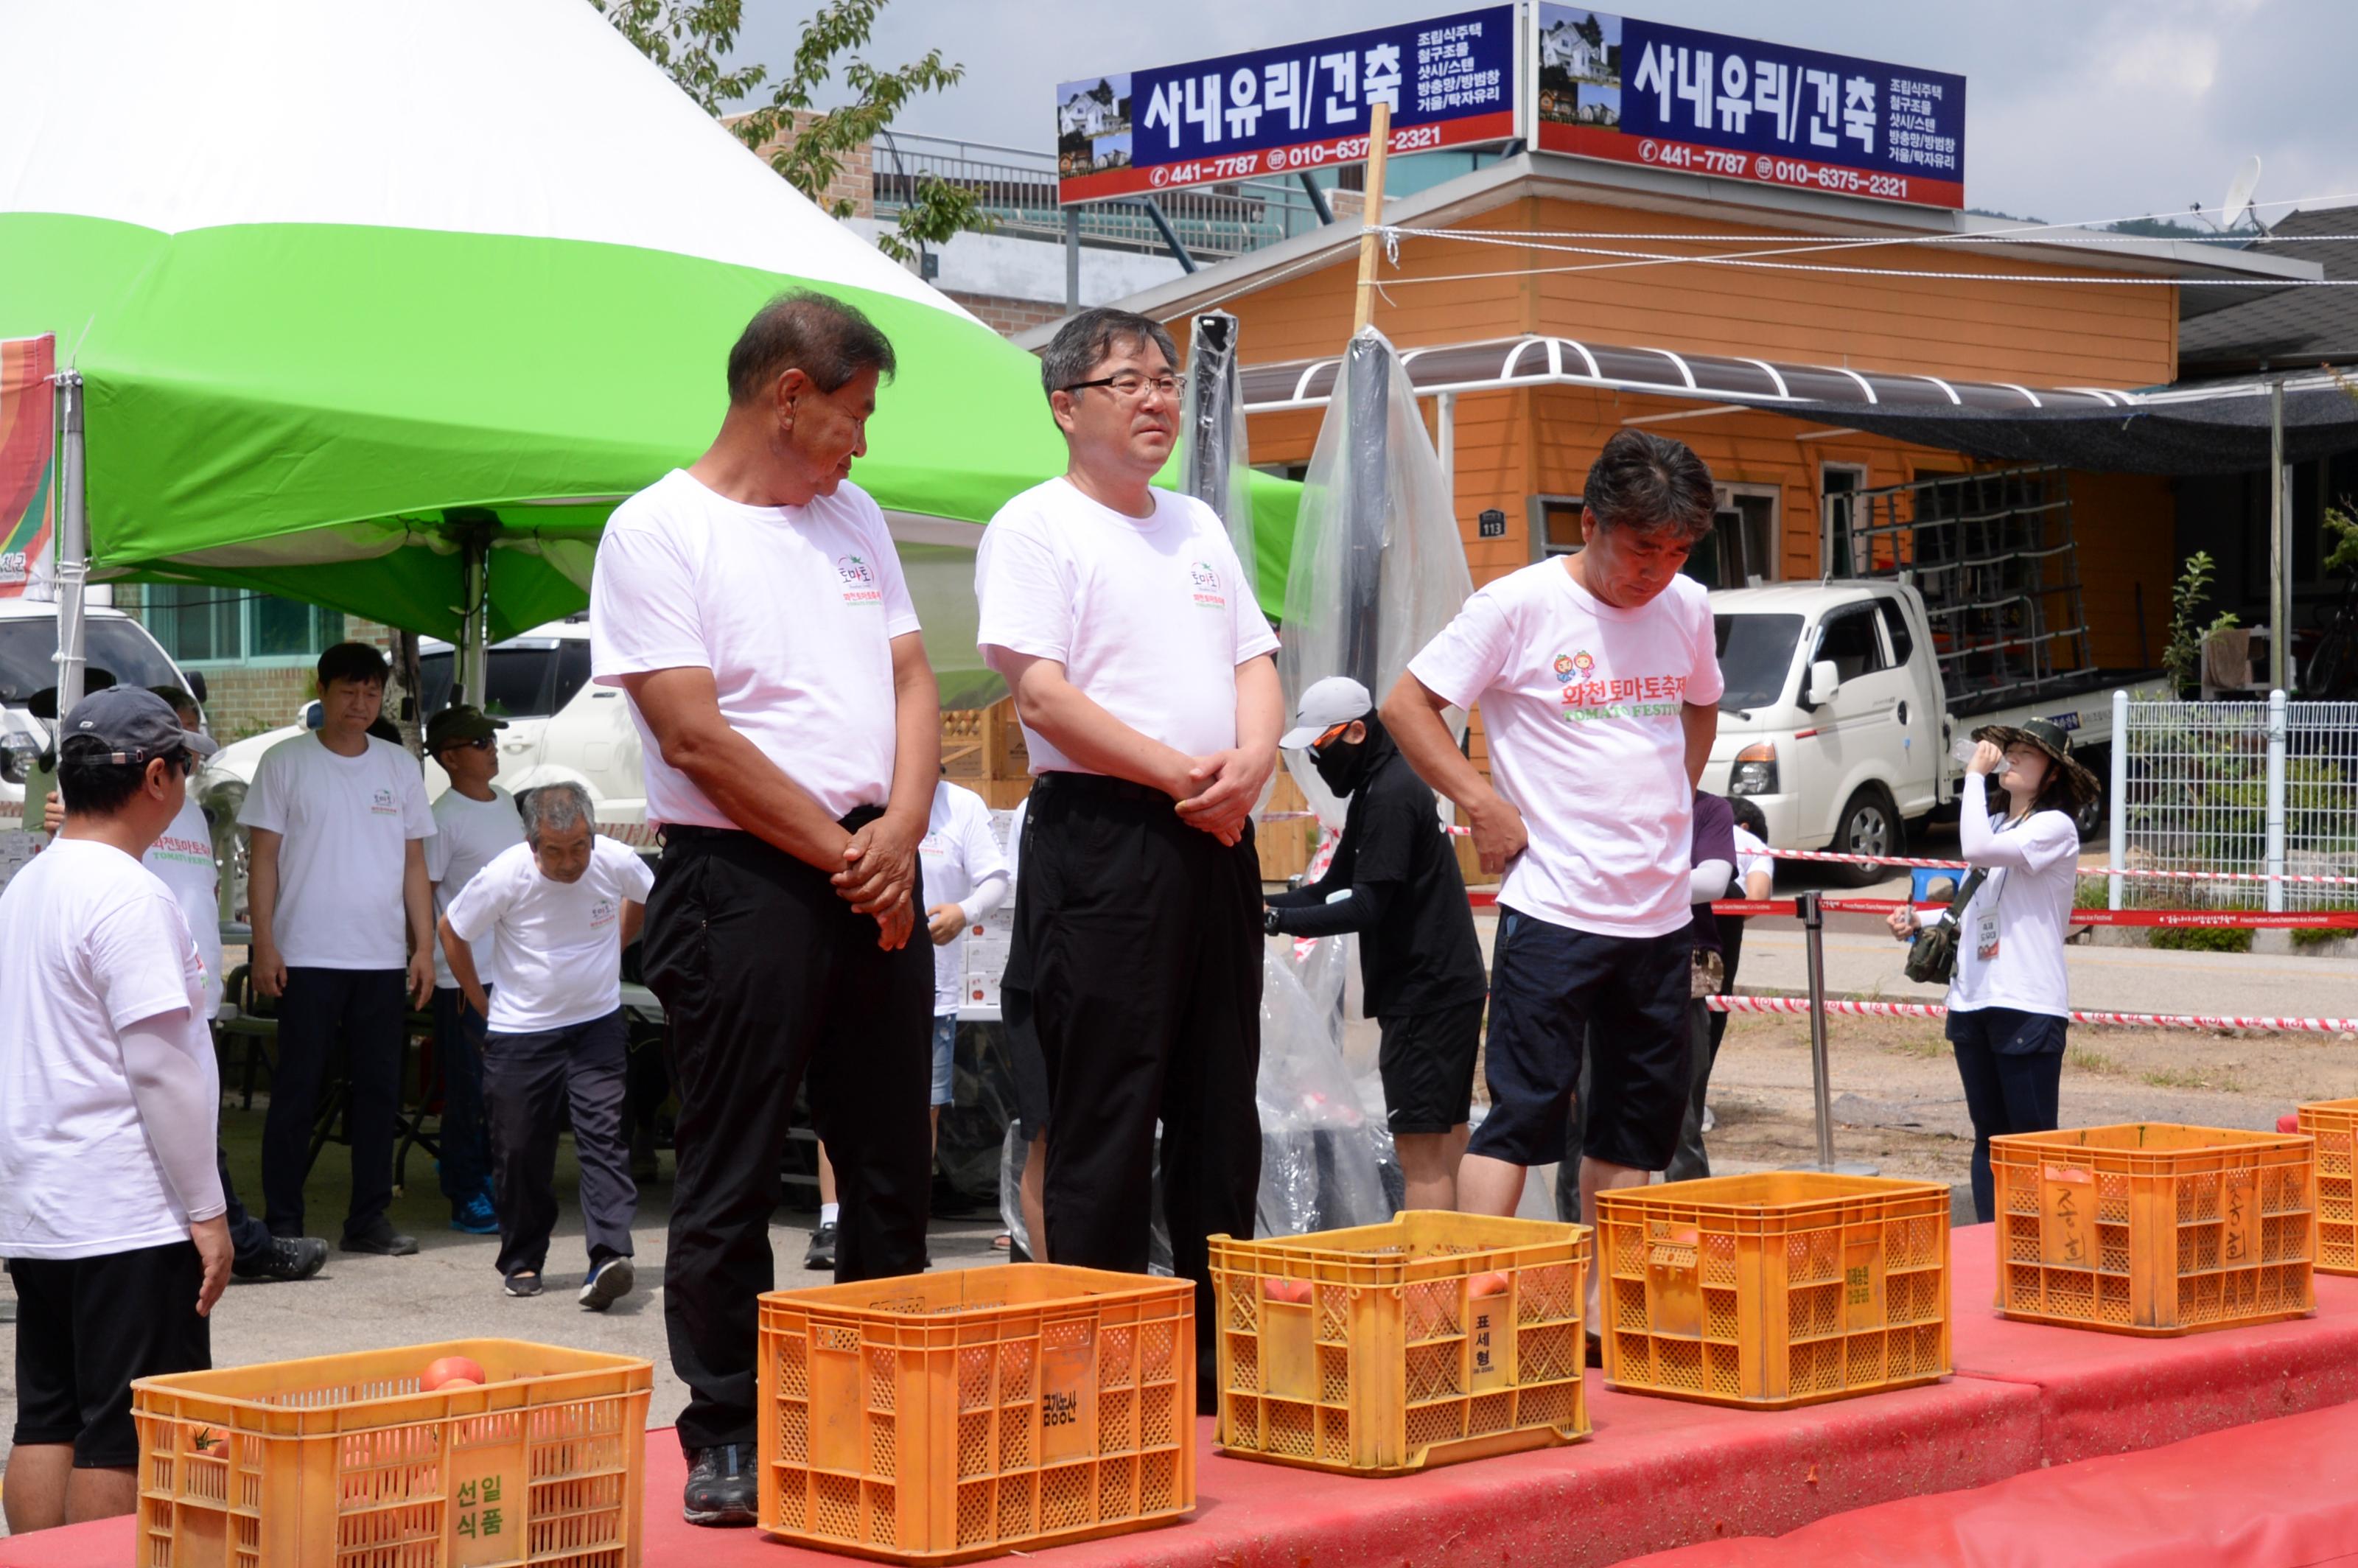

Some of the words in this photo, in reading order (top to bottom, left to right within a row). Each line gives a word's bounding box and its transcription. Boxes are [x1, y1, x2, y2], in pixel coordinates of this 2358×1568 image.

[1417, 21, 1483, 46] 조립식주택
[1417, 41, 1469, 64] 철구조물
[1144, 43, 1402, 148] 사내유리/건축
[1417, 85, 1500, 112] 거울/탁자유리
[1633, 41, 1877, 153] 사내유리/건축
[1889, 78, 1942, 101] 조립식주택
[1169, 155, 1259, 183] 441-7787
[1290, 126, 1441, 167] 010-637-2321
[1659, 144, 1747, 175] 441-7787
[1776, 161, 1909, 198] 010-6375-2321
[1483, 522, 1502, 536] 113
[0, 554, 25, 573] 천군
[838, 566, 871, 584] 토마토
[1191, 571, 1217, 588] 토마토
[1561, 673, 1687, 707] 화천토마토축제
[1475, 1315, 1490, 1366] 표세형
[1043, 1390, 1077, 1427] 금강농산
[457, 1474, 501, 1508] 선일
[457, 1508, 503, 1539] 식품
